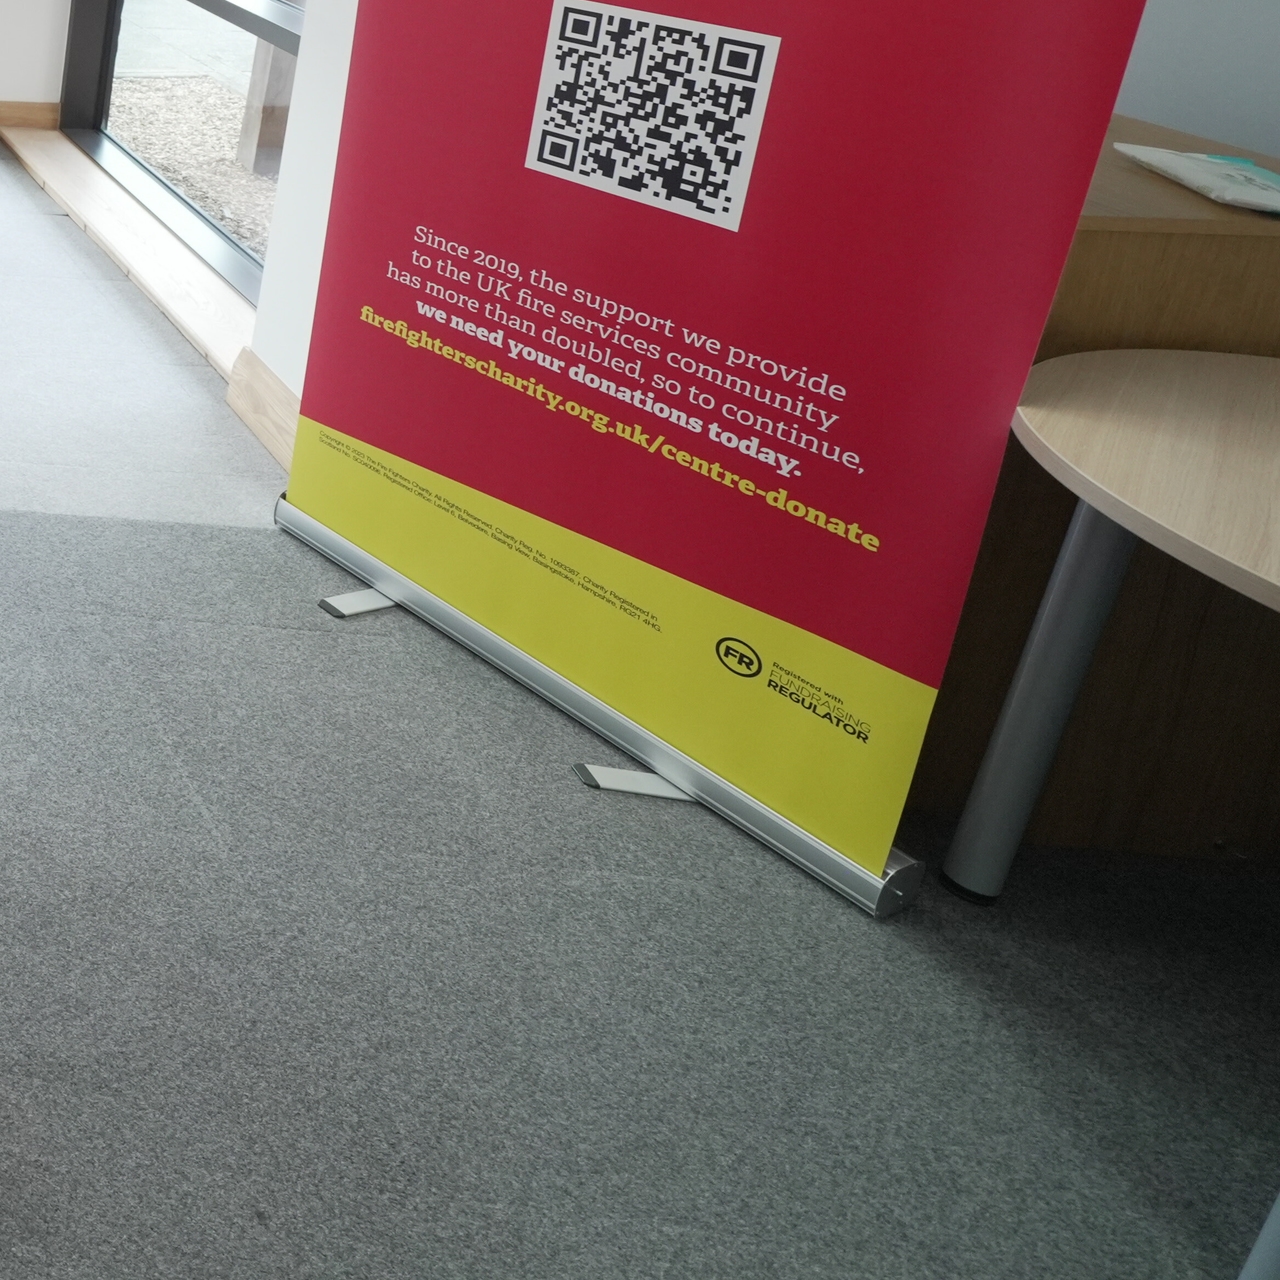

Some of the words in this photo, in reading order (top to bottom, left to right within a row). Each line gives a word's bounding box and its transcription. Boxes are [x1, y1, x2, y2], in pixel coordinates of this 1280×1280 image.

[386, 261, 421, 289] has
[425, 280, 479, 313] more
[484, 302, 536, 337] than
[541, 327, 645, 383] doubled,
[651, 373, 682, 395] so
[689, 386, 715, 410] to
[722, 403, 864, 474] continue,
[411, 249, 432, 269] to
[437, 260, 471, 284] the
[477, 272, 514, 301] UK
[516, 288, 556, 317] fire
[560, 310, 662, 359] services
[666, 352, 840, 433] community
[414, 225, 469, 259] Since
[473, 250, 523, 282] 2019,
[530, 269, 568, 296] the
[572, 287, 675, 337] support
[681, 327, 721, 355] we
[726, 345, 847, 402] provide
[416, 300, 447, 324] we
[449, 314, 504, 348] need
[507, 338, 566, 374] your
[568, 364, 703, 433] donations
[708, 422, 802, 478] today.
[359, 305, 880, 552] firefighterscharity.org.uk/centre-donate
[319, 430, 344, 448] Copyright
[366, 456, 377, 465] The
[377, 462, 388, 471] Fire
[388, 468, 411, 484] Fighters
[443, 498, 462, 513] Rights
[495, 527, 518, 544] Charity
[519, 540, 534, 553] Reg.
[536, 549, 547, 560] No.
[582, 575, 608, 594] Charity
[610, 590, 649, 617] Registered
[650, 613, 658, 621] in
[319, 436, 341, 452] Scotland
[342, 449, 351, 458] No.
[383, 472, 413, 493] Registered
[434, 501, 450, 513] Level
[491, 532, 513, 550] Basing
[514, 545, 531, 560] View,
[532, 555, 576, 585] Basingstoke,
[577, 581, 617, 609] Hampshire,
[619, 604, 641, 621] RG21
[642, 618, 662, 633] 4HG.
[723, 644, 754, 671] FR
[767, 678, 869, 744] REGULATOR
[769, 670, 871, 734] FUNDRAISING
[772, 661, 822, 693] Registered
[823, 690, 844, 706] with
